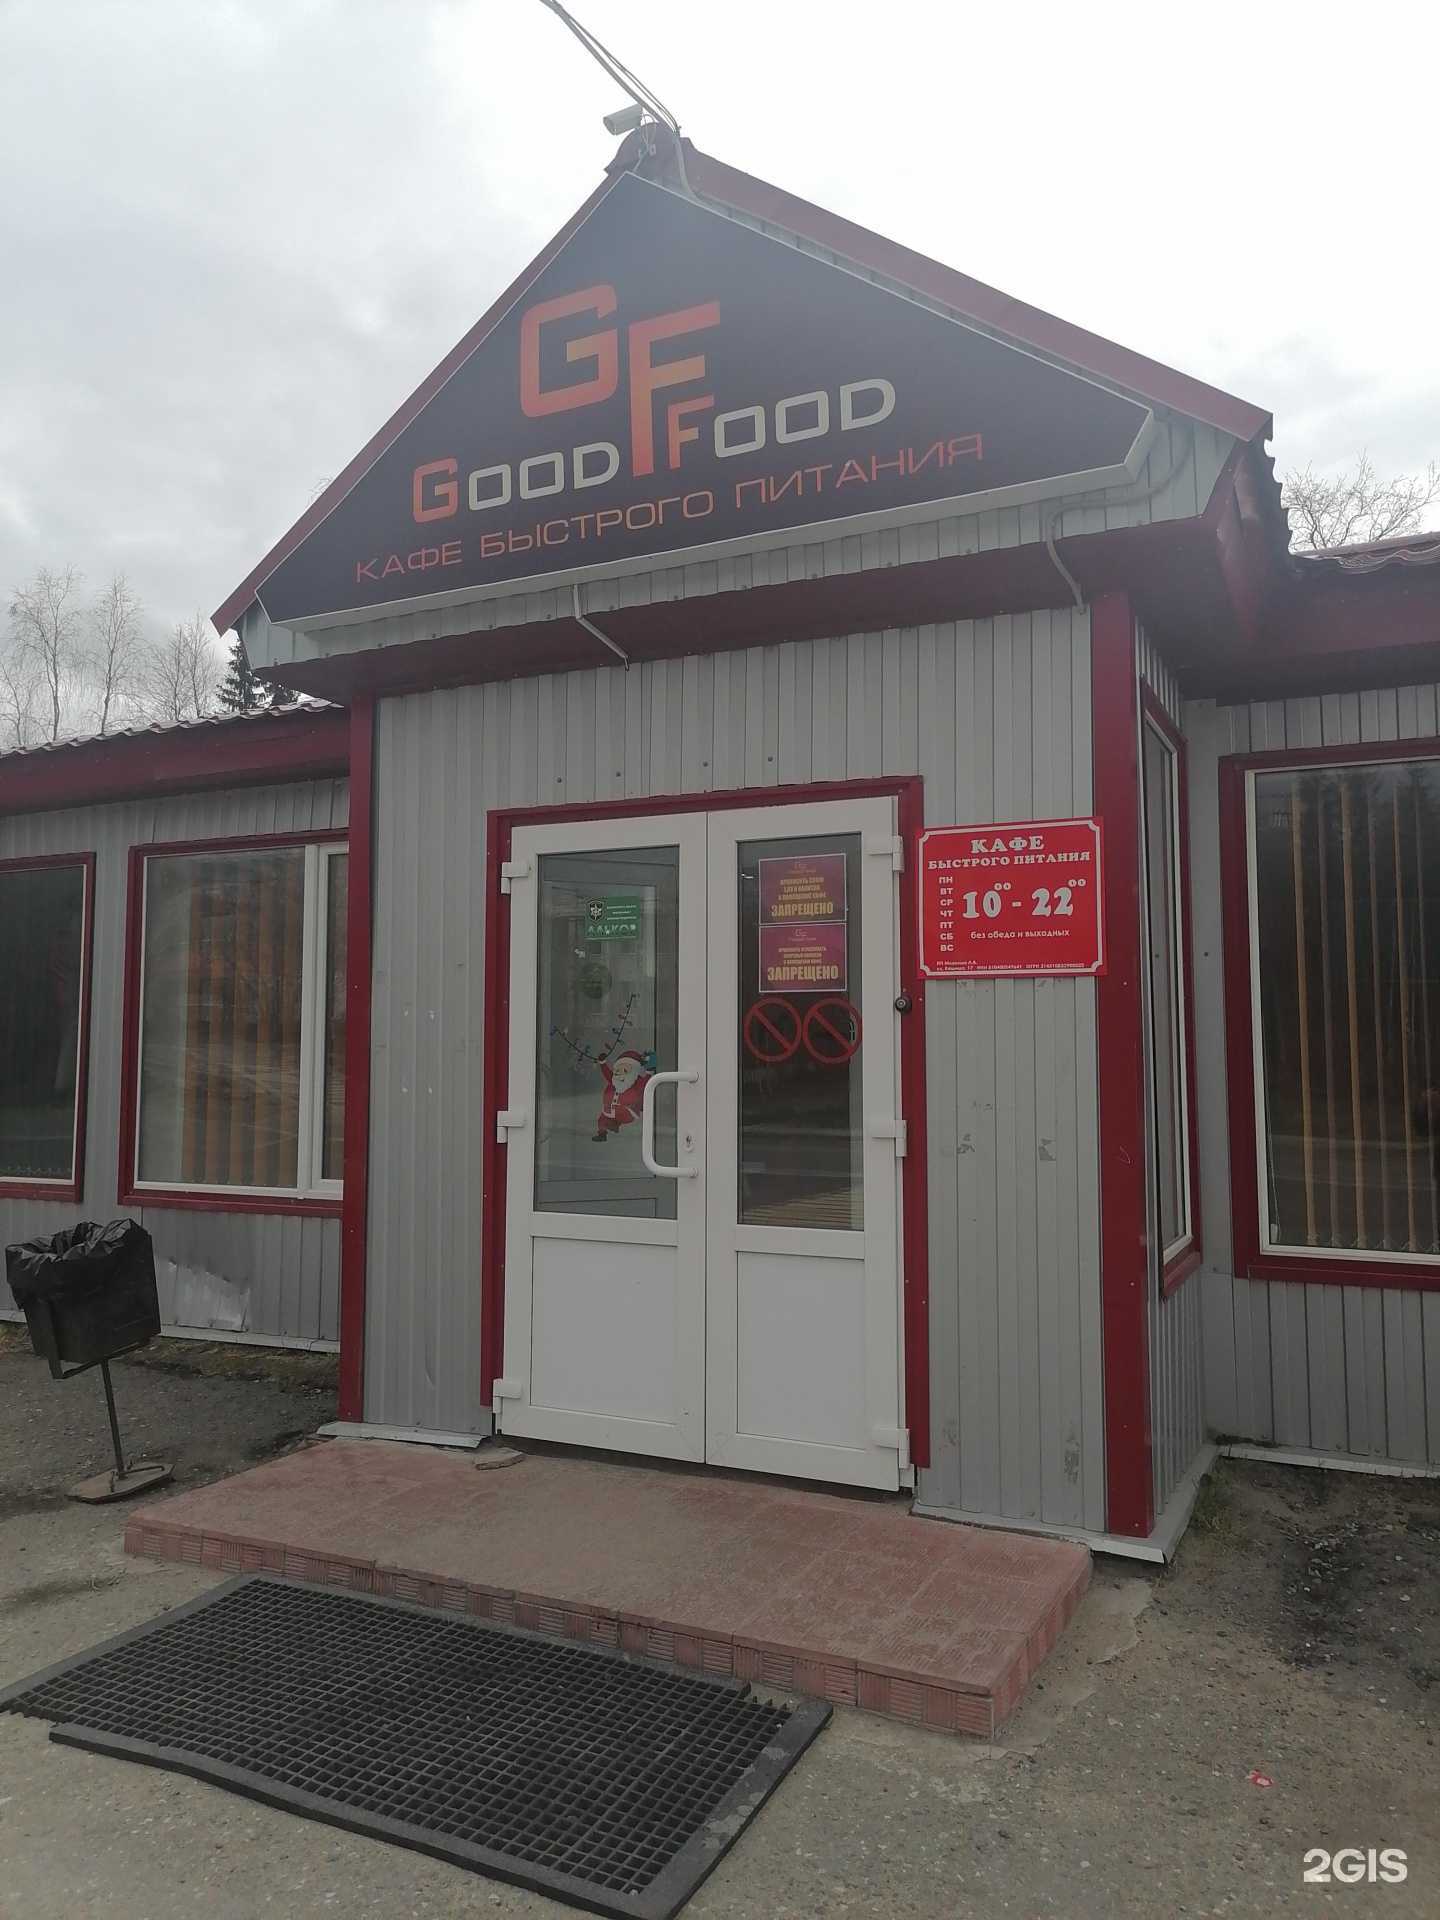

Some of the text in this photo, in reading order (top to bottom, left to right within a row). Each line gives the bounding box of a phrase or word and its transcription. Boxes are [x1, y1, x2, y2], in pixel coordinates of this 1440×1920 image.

[412, 378, 896, 523] GOOD FOOD
[355, 433, 984, 583] КАФЕ БЫСТРОГО ПИТАНИЯ
[970, 835, 1045, 854] КАФЕ
[927, 851, 1091, 870] БЫСТРОГО ПИТАНИЯ
[938, 876, 953, 884] ПН
[939, 887, 954, 895] ВТ
[939, 898, 954, 907] СР
[771, 901, 834, 918] ЗАПРЕЩЕНО
[939, 910, 954, 918] ЧТ
[939, 921, 954, 929] ПТ
[970, 929, 1070, 939] без обеда и выходных
[939, 944, 954, 952] ВС
[767, 965, 839, 982] ЗАПРЕЩЕНО
